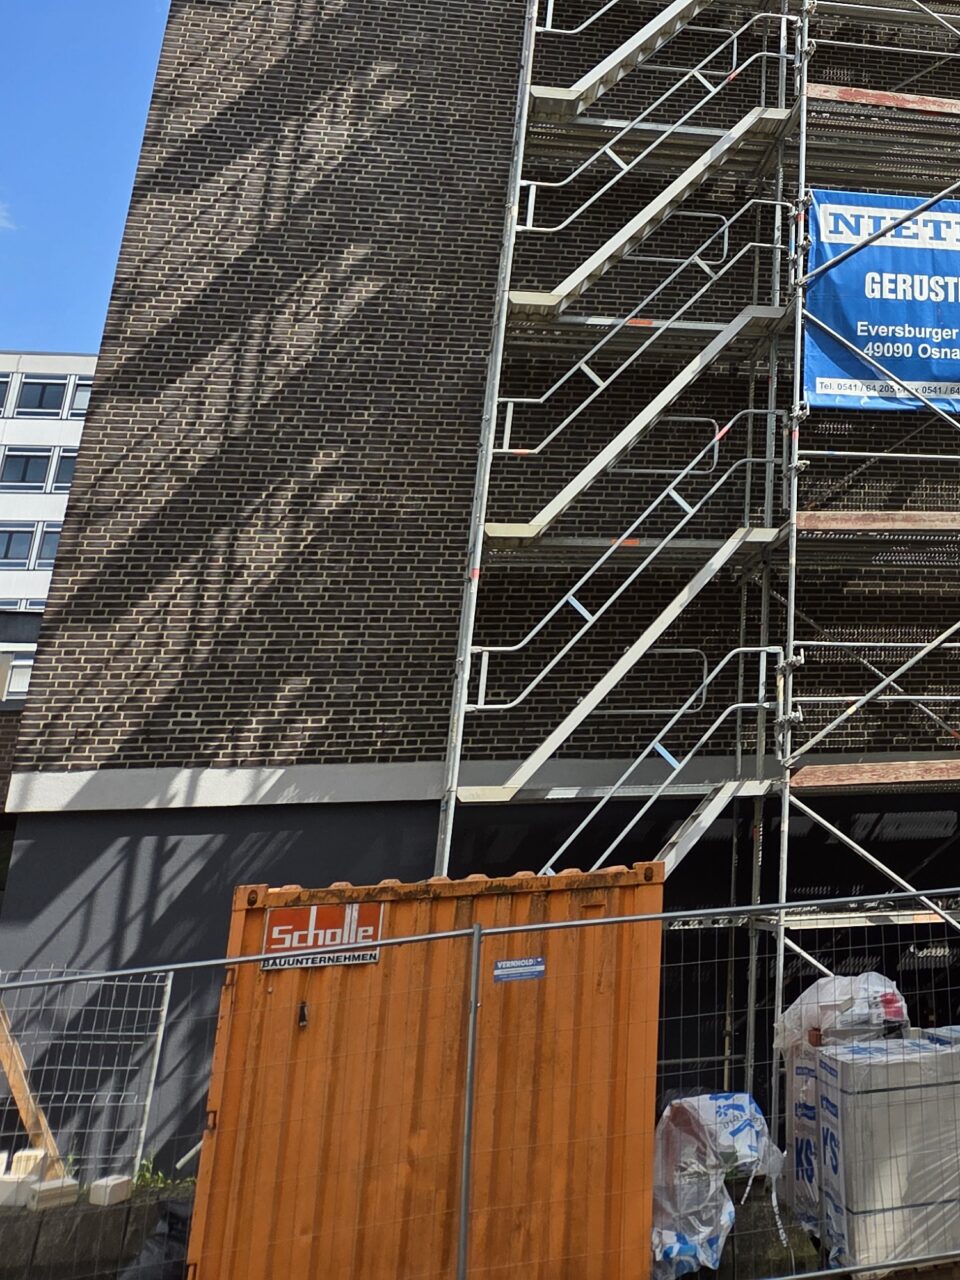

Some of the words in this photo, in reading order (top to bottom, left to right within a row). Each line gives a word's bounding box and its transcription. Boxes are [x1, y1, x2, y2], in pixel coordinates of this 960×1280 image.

[856, 321, 959, 342] Eversburger
[864, 342, 913, 358] 49090
[819, 381, 834, 390] Tel.
[837, 382, 858, 391] 0541
[866, 384, 877, 392] 64
[879, 384, 895, 393] 205
[922, 386, 942, 395] 0541
[950, 386, 960, 395] 64
[270, 904, 374, 949] Scholle
[262, 953, 378, 969] BAUUNTERNEHMEN
